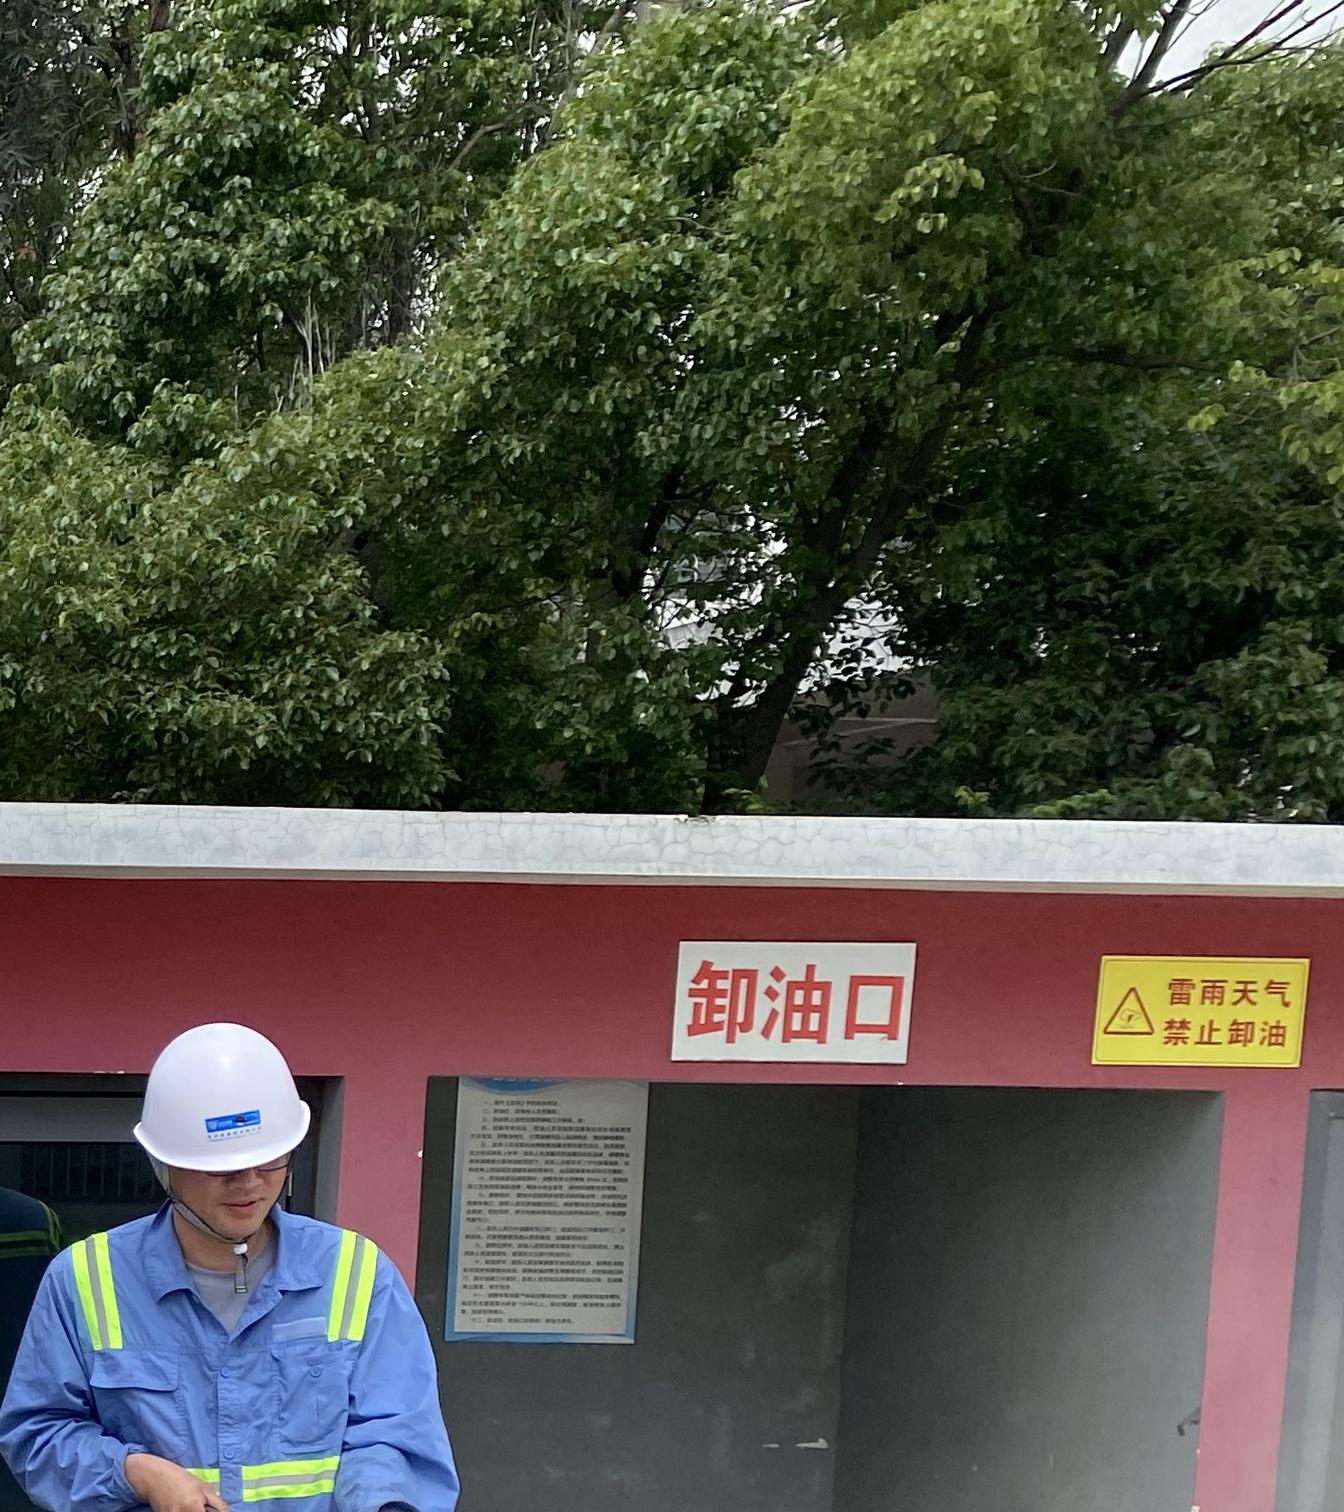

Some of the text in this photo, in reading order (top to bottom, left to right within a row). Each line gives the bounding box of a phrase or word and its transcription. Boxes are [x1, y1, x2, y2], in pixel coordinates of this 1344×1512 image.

[686, 959, 906, 1045] 卸油口
[1166, 976, 1293, 1010] 雷雨天气
[1162, 1018, 1289, 1049] 禁止卸油
